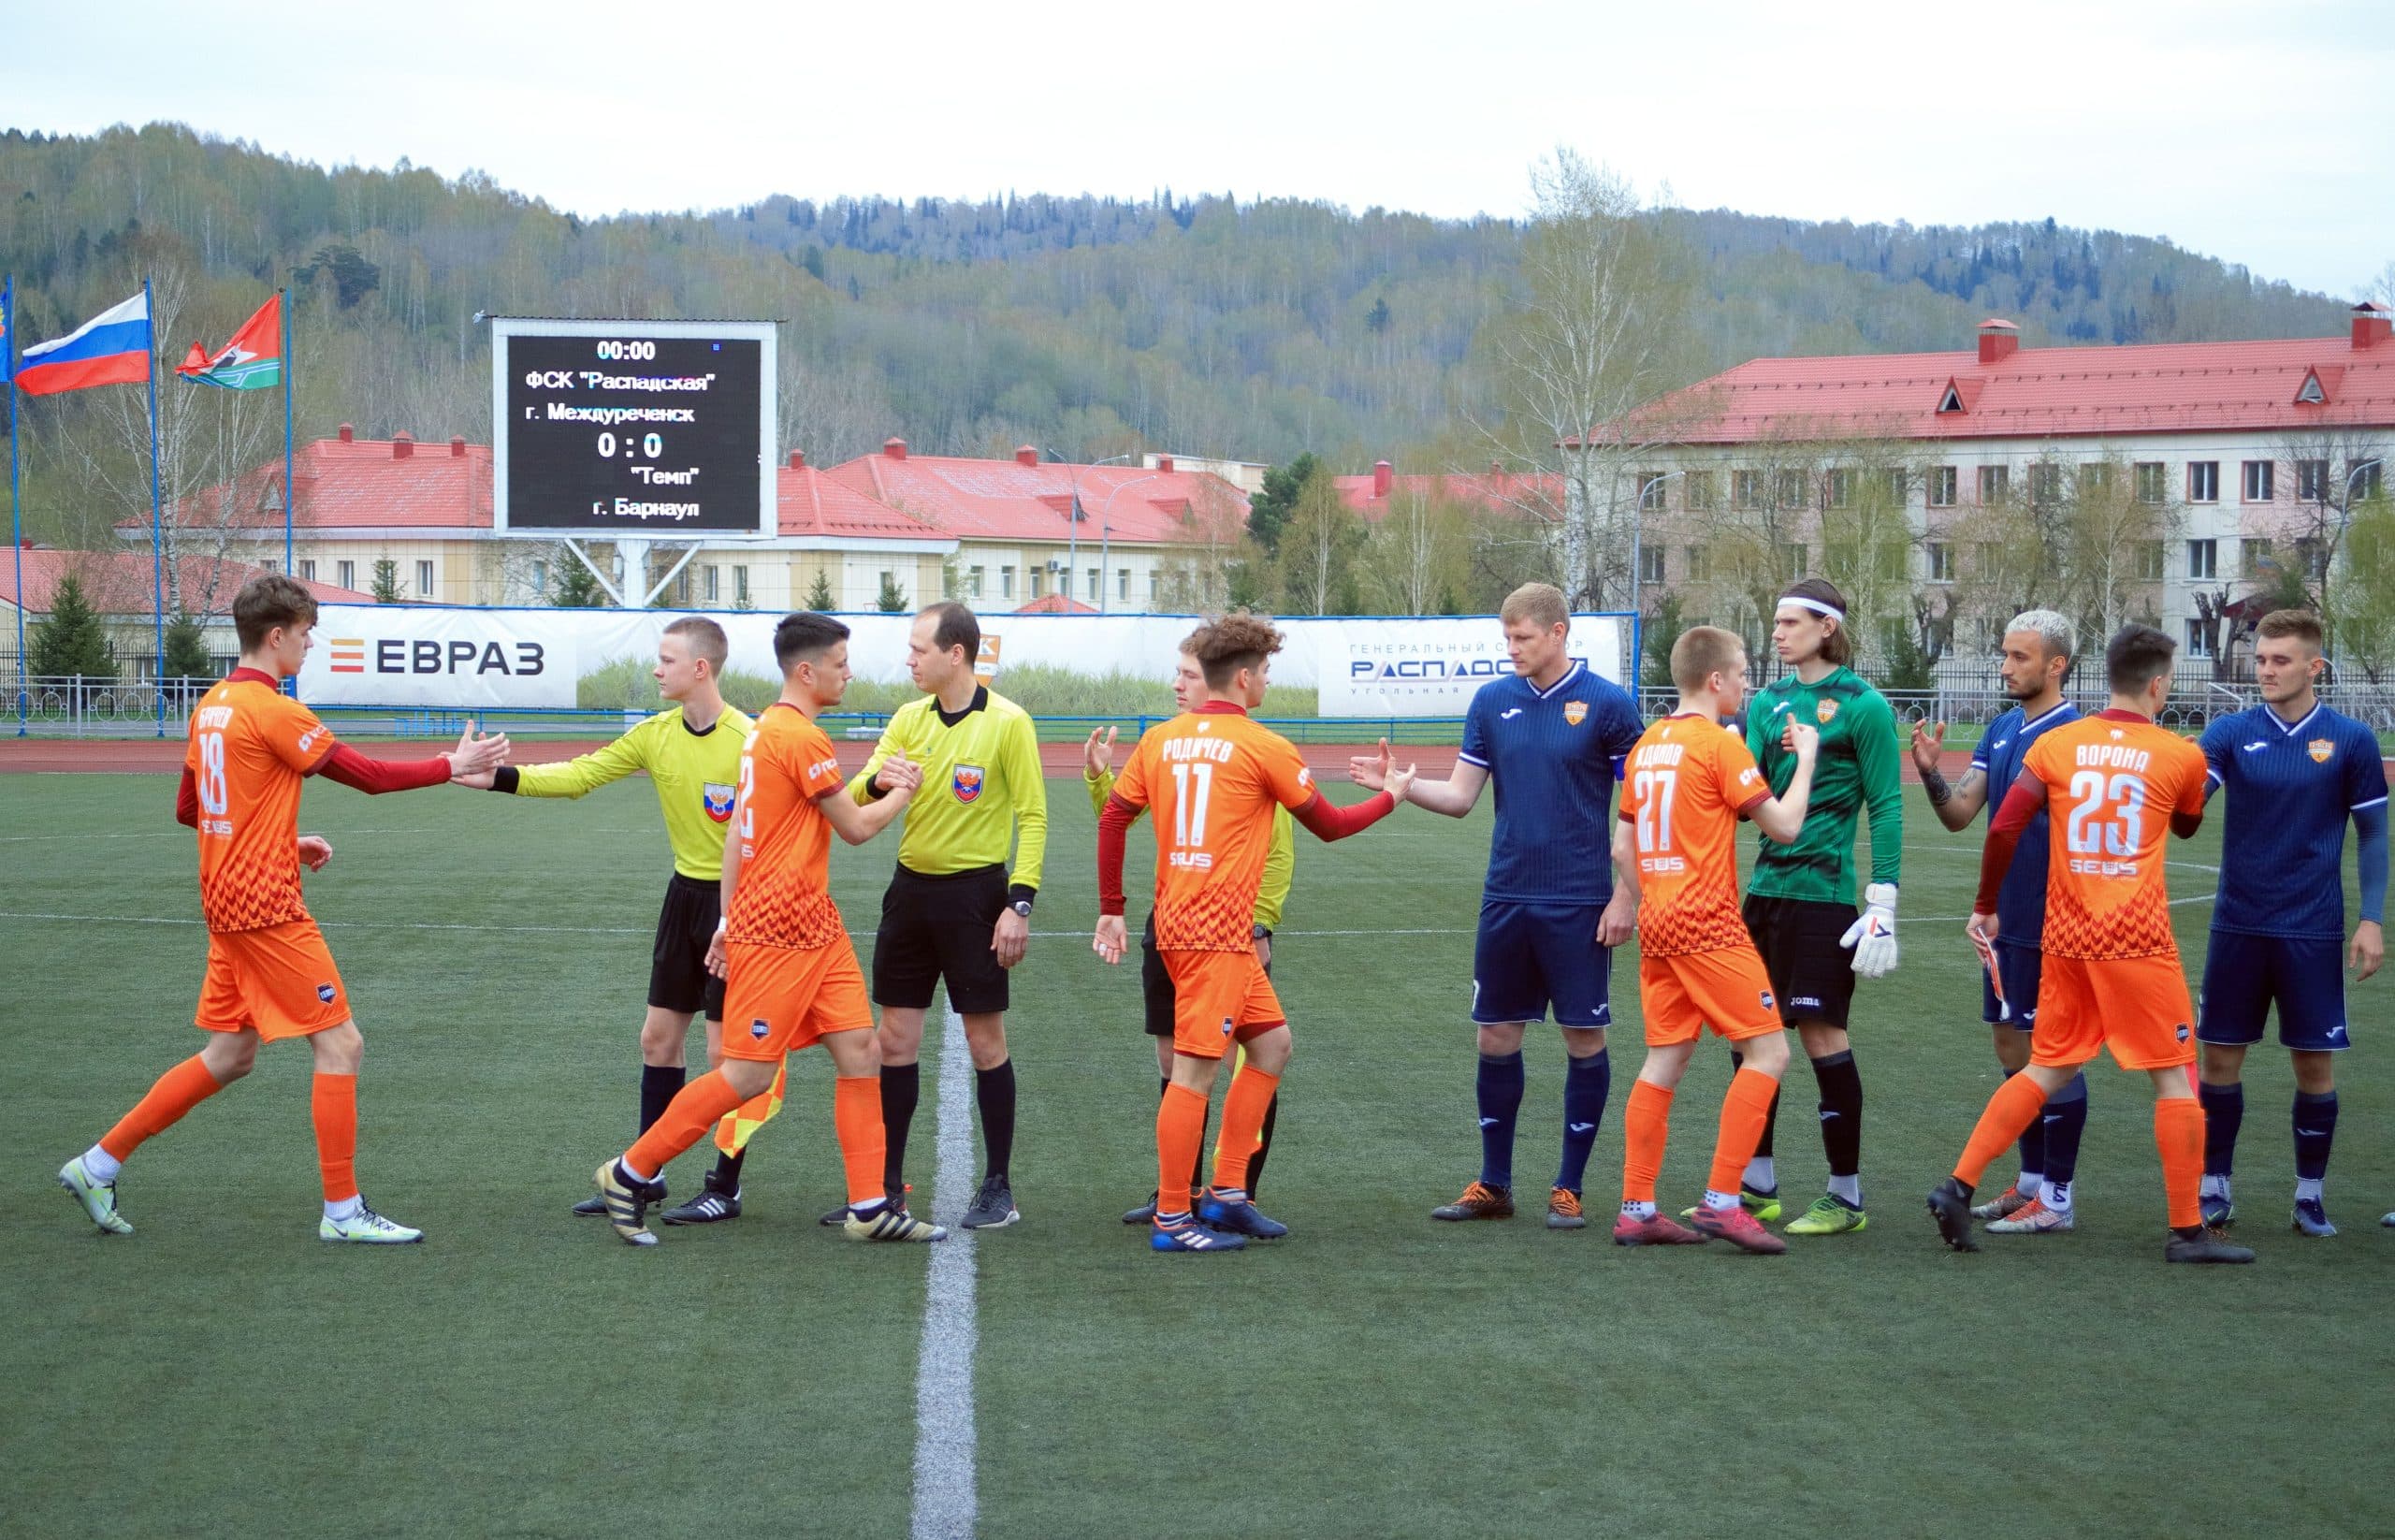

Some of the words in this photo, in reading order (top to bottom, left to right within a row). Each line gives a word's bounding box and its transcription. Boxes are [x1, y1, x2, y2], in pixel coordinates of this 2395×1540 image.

[597, 341, 655, 360] 00:00
[525, 370, 574, 389] ФСК
[525, 407, 540, 421] г.
[547, 402, 695, 425] Междуреченск
[630, 466, 700, 486] "Темп"
[592, 501, 608, 516] г.
[614, 497, 700, 521] Барнаул
[376, 638, 545, 676] ЕВРАЗ
[1349, 642, 1485, 654] ГЕНЕРАЛЬНЫЙ
[1351, 687, 1459, 695] УГОЛЬНАЯ
[1162, 737, 1234, 763] РОДИЧЕВ
[2076, 745, 2150, 773] ВОРОНА
[198, 733, 227, 815] 18
[1171, 763, 1212, 847] 11
[1634, 770, 1676, 852] 27
[2068, 771, 2146, 856] 23
